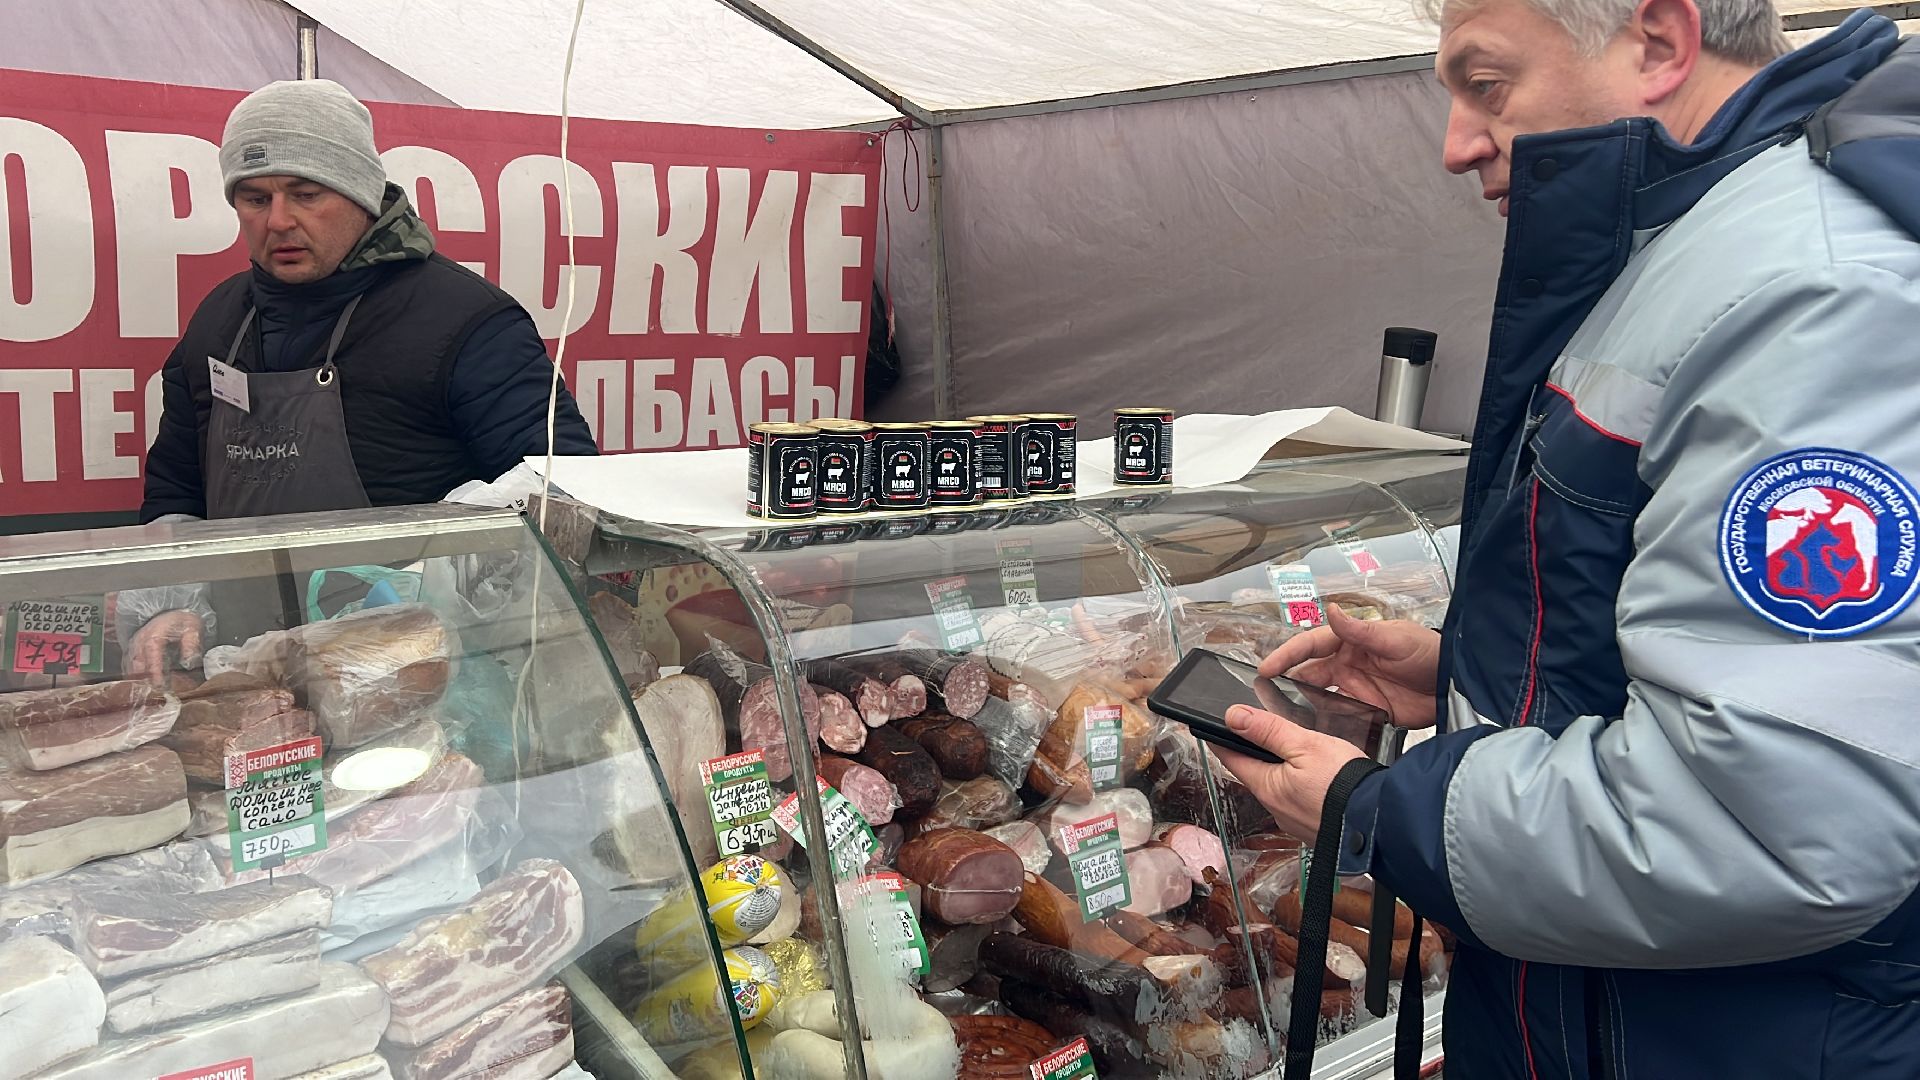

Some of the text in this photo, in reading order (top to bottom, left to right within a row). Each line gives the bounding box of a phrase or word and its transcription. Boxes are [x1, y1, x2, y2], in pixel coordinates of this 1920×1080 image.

[0, 117, 866, 341] ОРССКИЕ
[553, 355, 856, 451] ЛБАСЫ
[226, 442, 300, 460] ЯРМАРКА
[1757, 476, 1886, 516] МОСКОВСКОЙ ОБЛАСТИ
[1730, 459, 1917, 578] ГОСУДАРСТВЕННАЯ ВЕТЕРИНАРНАЯ СЛУЖБА
[247, 744, 316, 771] БЕЛОРУССКИЕ
[263, 763, 302, 779] ПРОДУКТЫ
[711, 752, 762, 772] БЕЛОРУССКИЕ
[723, 765, 755, 778] ПРОДУКТЫ
[1074, 817, 1116, 840] БЕЛОРУССКИЕ
[1042, 1042, 1087, 1075] БЕЛОРУССКИЕ
